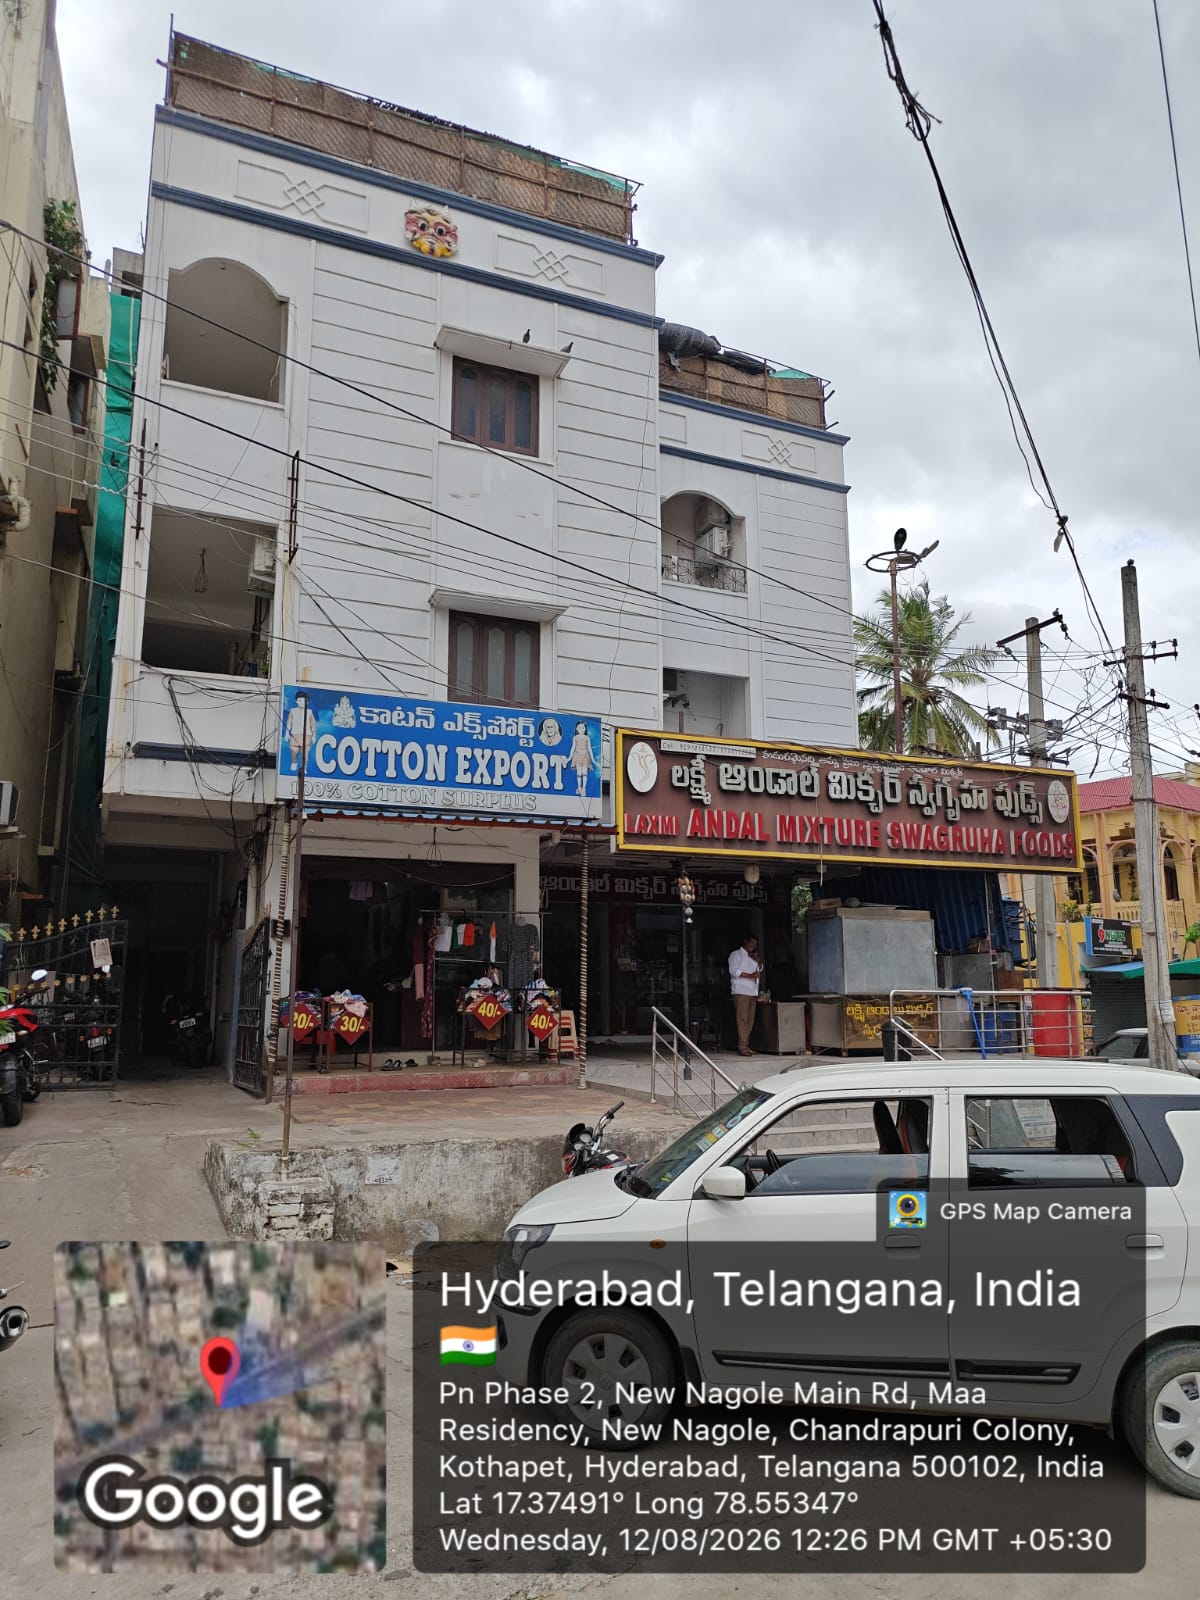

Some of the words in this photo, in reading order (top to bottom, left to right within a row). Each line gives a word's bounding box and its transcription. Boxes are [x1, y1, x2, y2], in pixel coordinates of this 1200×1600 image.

[359, 706, 436, 729] కాటన్
[315, 733, 448, 782] COTTON
[455, 746, 568, 790] EXPORT
[349, 782, 437, 805] COTTON
[441, 789, 537, 811] SURPLUS
[719, 763, 821, 798] ఆండాల్
[827, 767, 902, 813] మిక్చర్
[624, 812, 679, 836] LAXMI
[686, 808, 770, 842] ANDAL
[776, 814, 882, 848] MIXTURE
[887, 821, 1006, 855] SWAGRUHA
[1010, 829, 1076, 858] FOODS
[478, 1002, 501, 1018] 40/-
[530, 1014, 553, 1030] 40/-
[340, 1017, 366, 1033] 30/-
